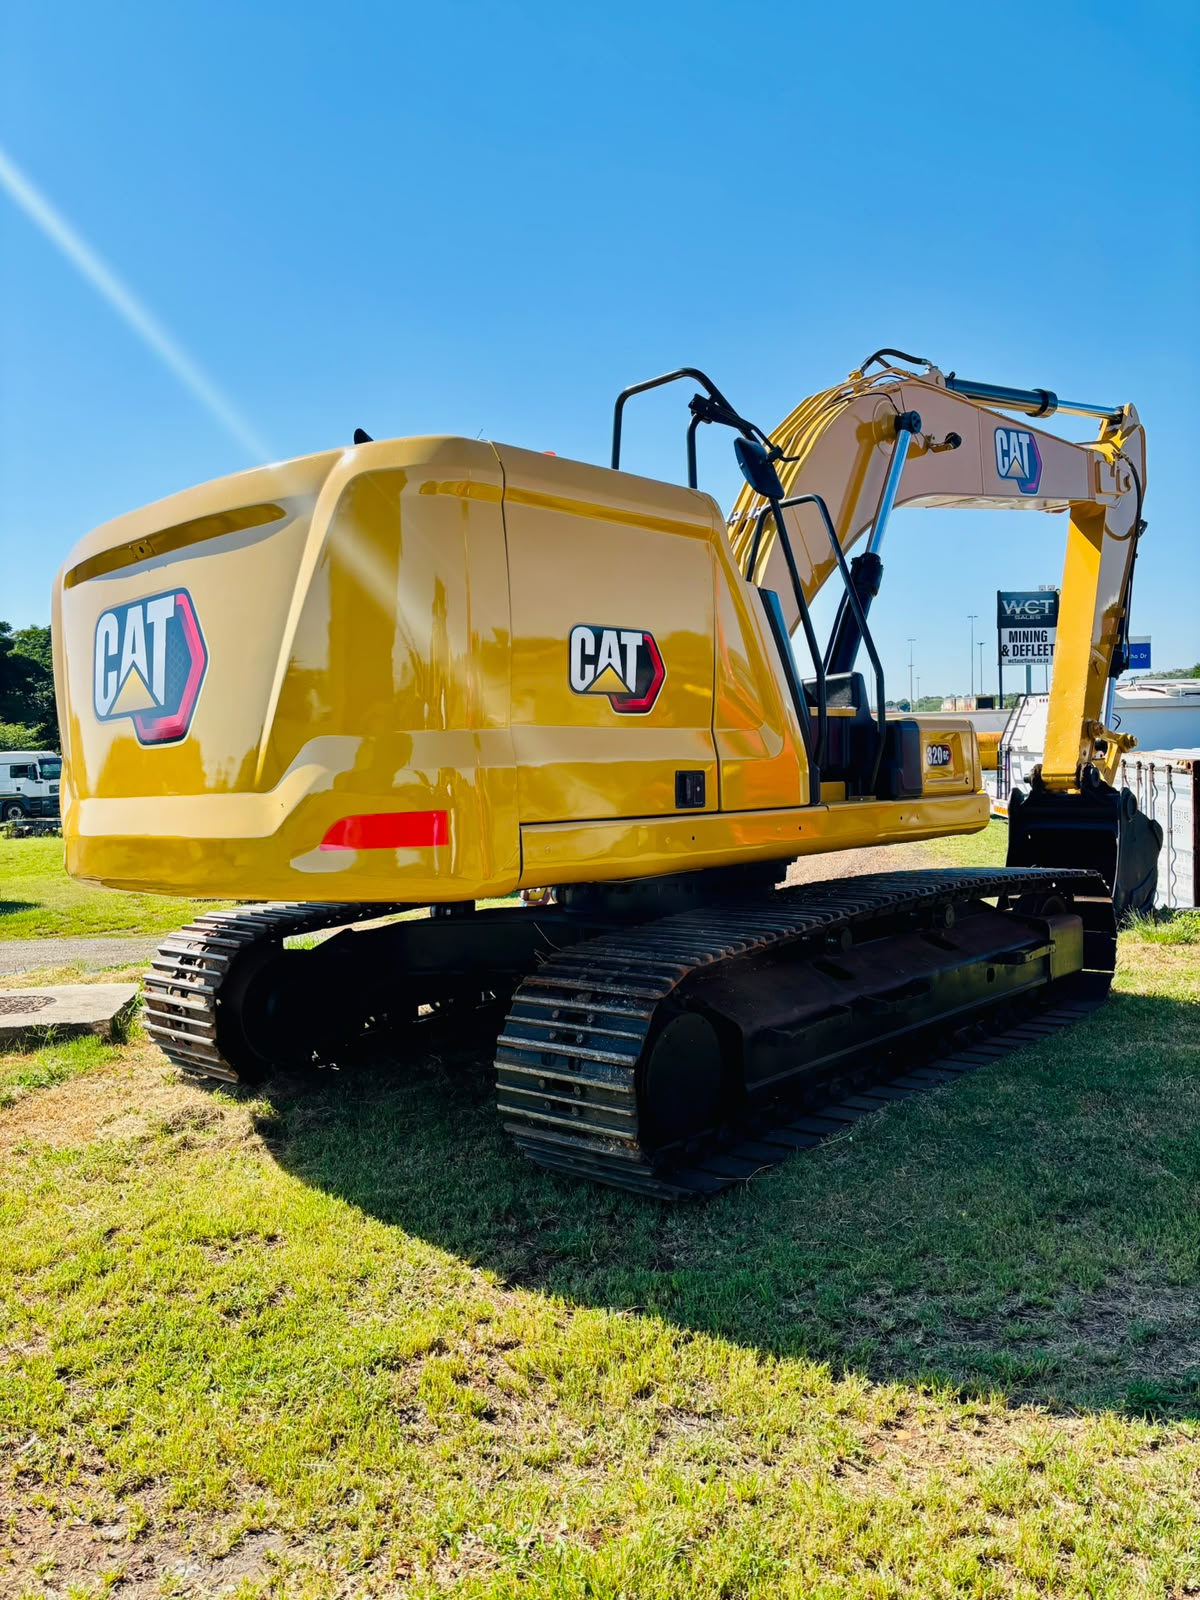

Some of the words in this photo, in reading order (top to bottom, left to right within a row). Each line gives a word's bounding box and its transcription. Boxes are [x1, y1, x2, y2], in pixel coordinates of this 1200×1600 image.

[995, 428, 1030, 479] CAT
[1001, 599, 1055, 615] WCT
[1008, 630, 1048, 643] MINING
[95, 594, 175, 717] CAT
[570, 626, 643, 693] CAT
[1001, 644, 1010, 657] &
[1012, 643, 1056, 657] DEFLEET
[927, 746, 943, 765] 320
